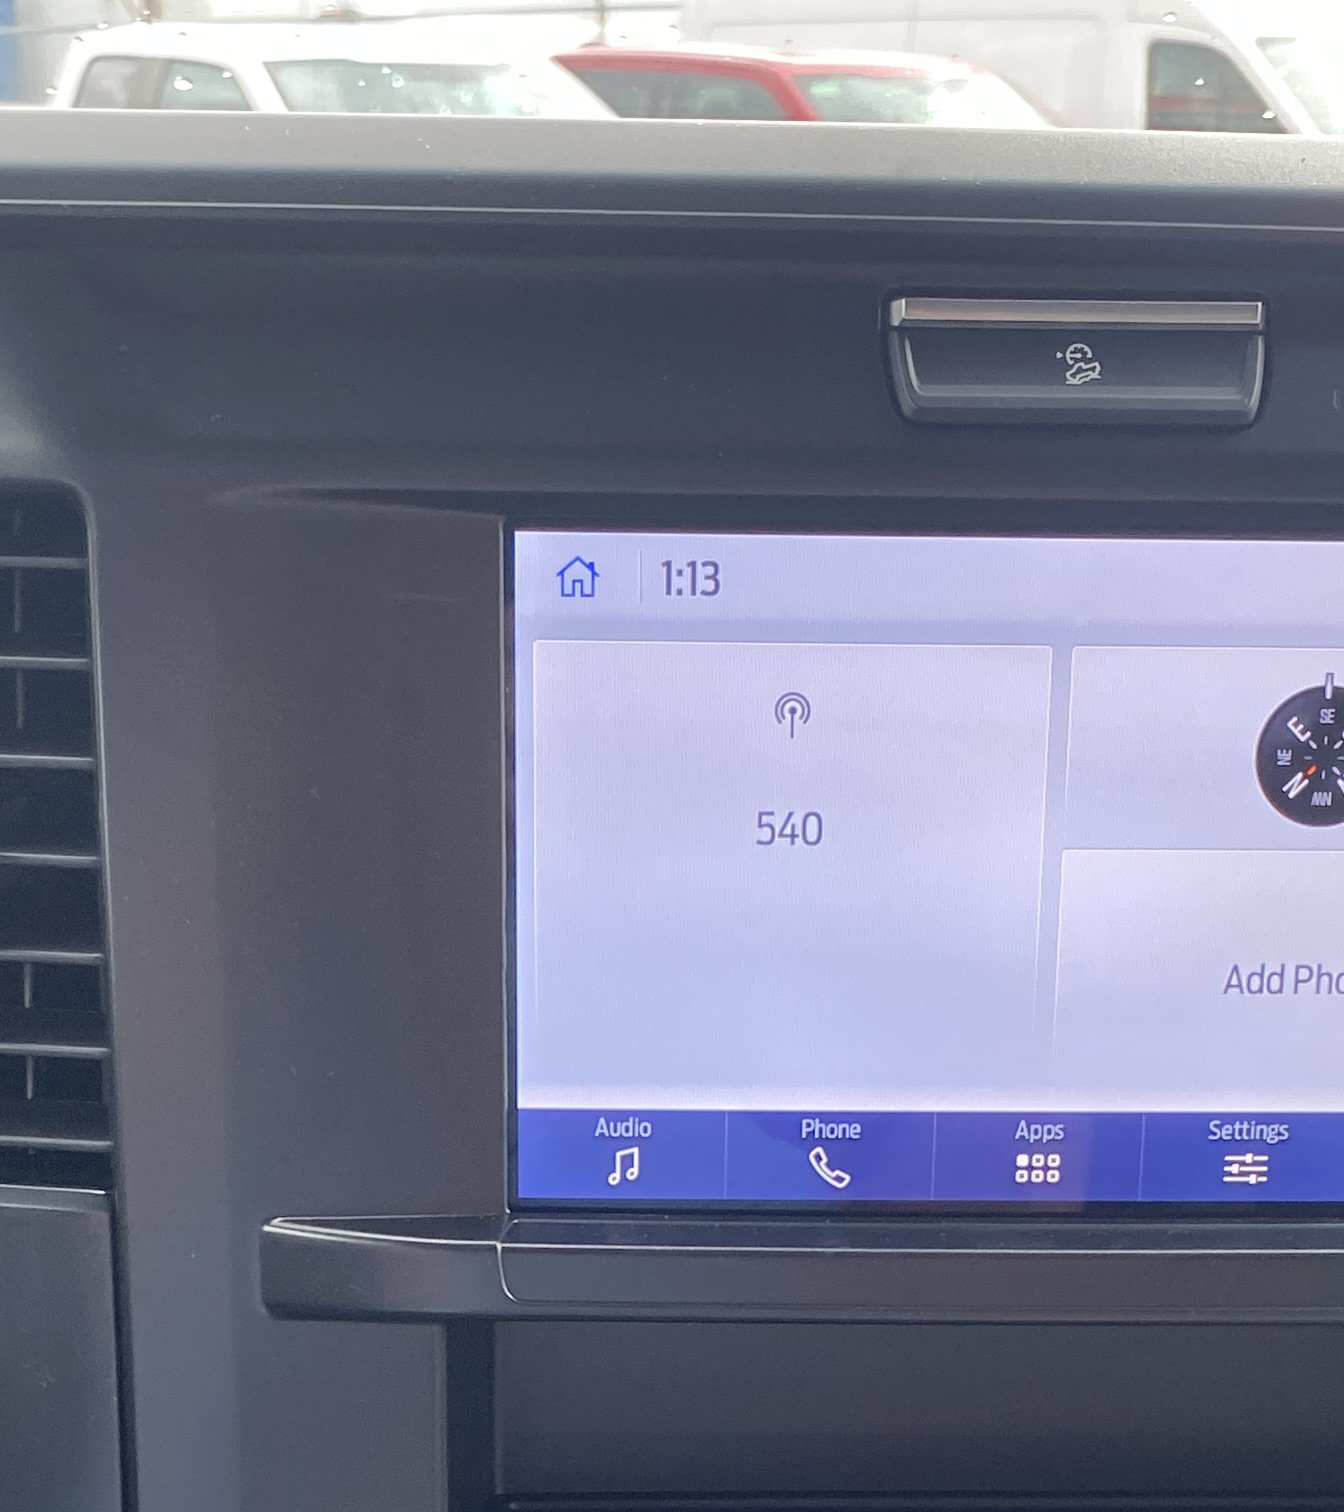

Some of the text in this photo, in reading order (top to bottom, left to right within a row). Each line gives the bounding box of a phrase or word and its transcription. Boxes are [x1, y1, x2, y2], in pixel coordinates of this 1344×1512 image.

[661, 560, 721, 597] 1:13
[1320, 708, 1336, 724] SE
[1286, 716, 1312, 743] E
[1281, 771, 1310, 799] N
[756, 811, 823, 846] 540
[1223, 962, 1286, 996] Add
[594, 1117, 652, 1138] Audio
[801, 1119, 862, 1140] Phone
[1015, 1120, 1065, 1142] Apps
[1208, 1121, 1290, 1143] Settings
